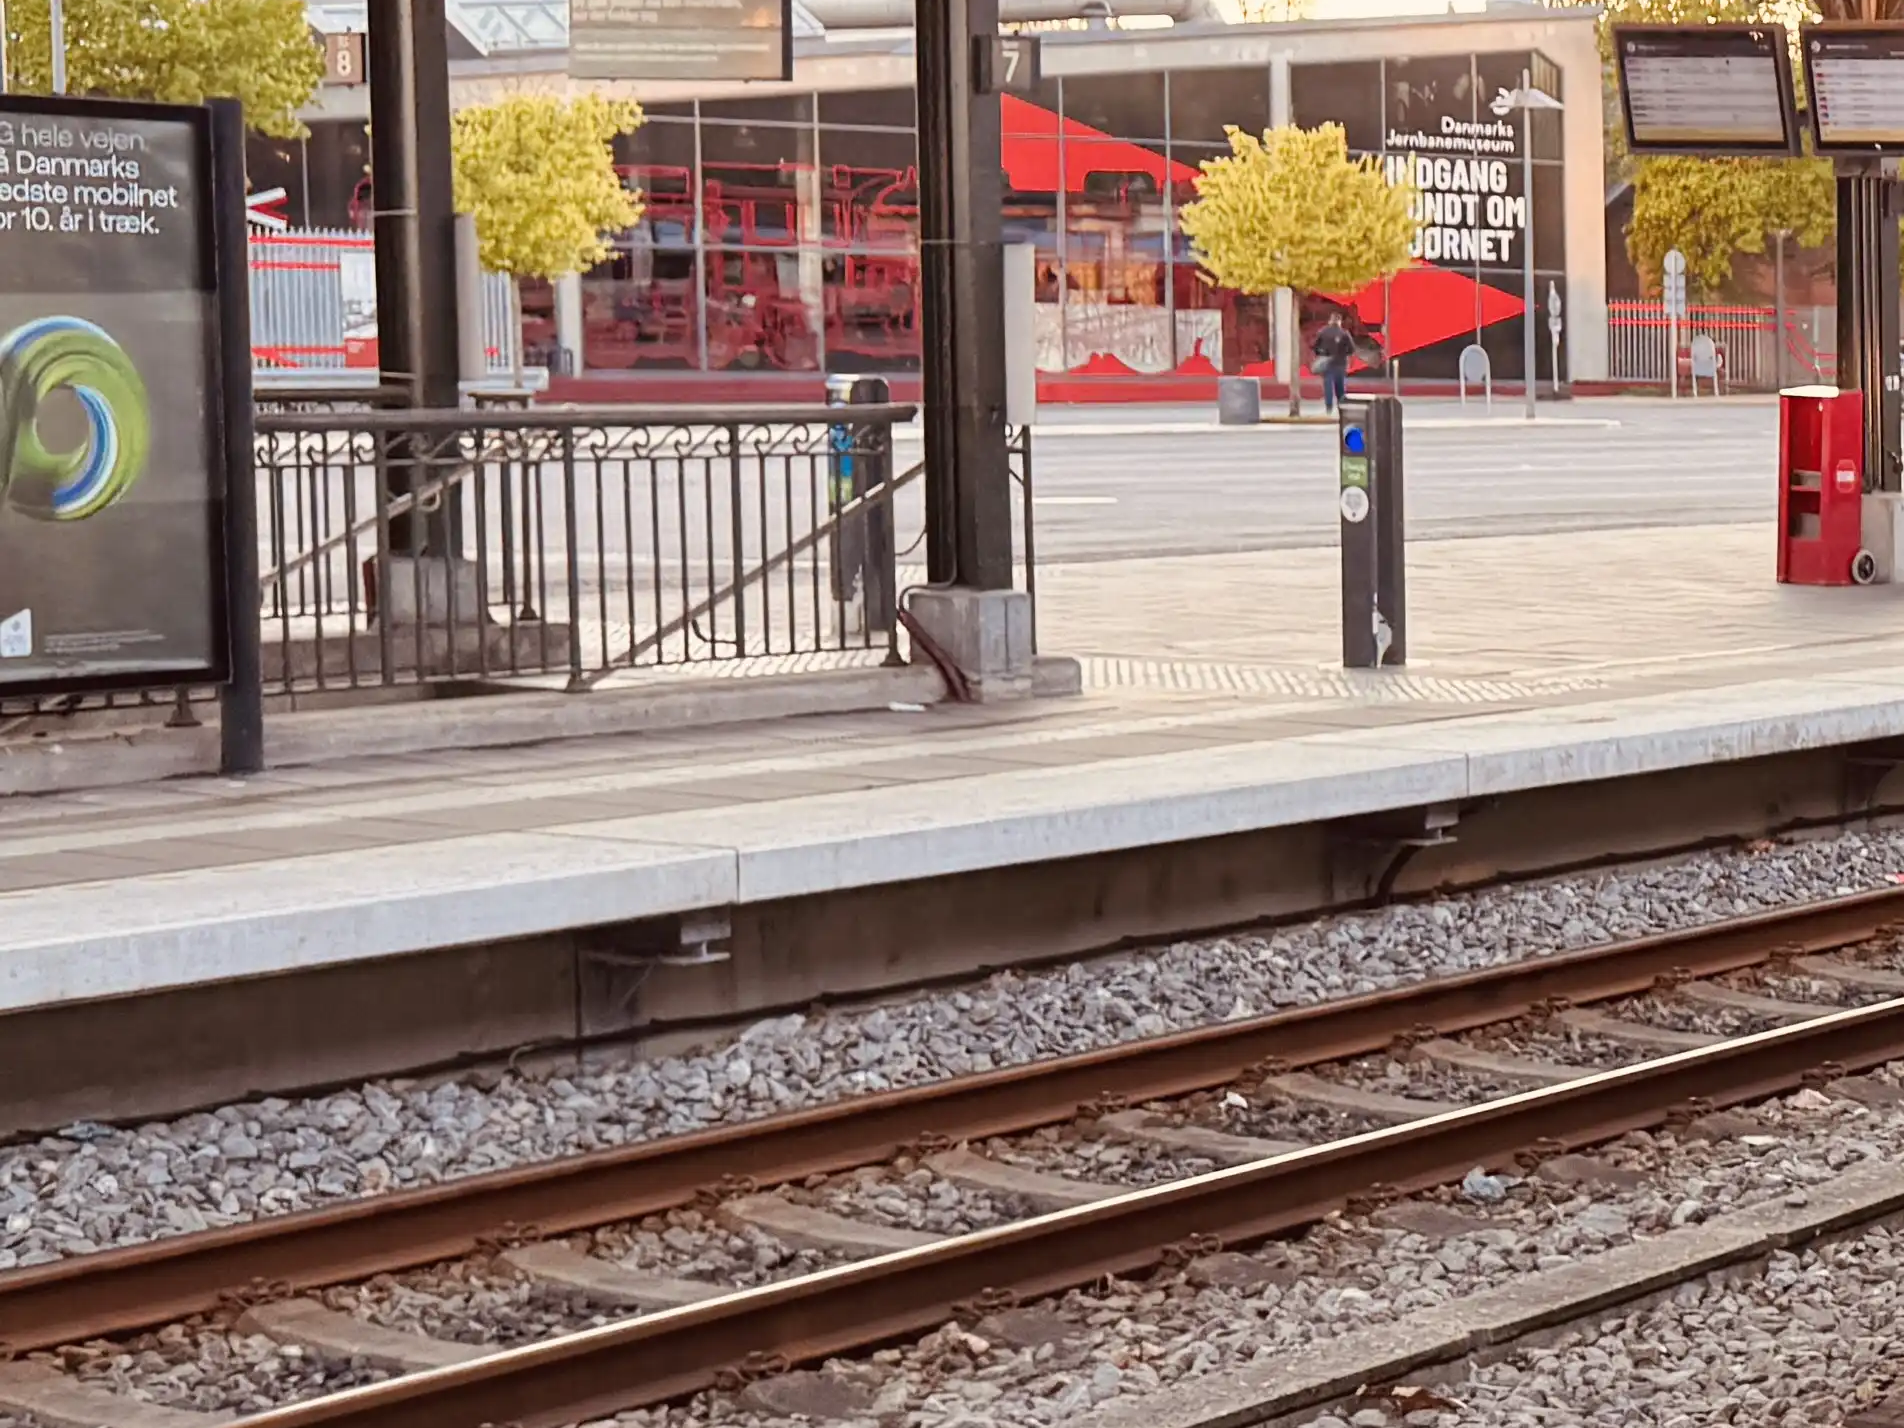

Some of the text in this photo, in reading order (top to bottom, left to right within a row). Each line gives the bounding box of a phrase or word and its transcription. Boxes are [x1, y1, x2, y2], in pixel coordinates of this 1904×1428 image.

[337, 50, 351, 76] 8
[1002, 51, 1019, 82] 7
[21, 123, 73, 148] hele
[1441, 115, 1514, 137] Danmarks
[16, 150, 140, 180] Danmarks
[1386, 155, 1508, 193] INDGANG
[0, 178, 178, 208] edste mobilnet
[21, 206, 54, 231] 10.
[60, 206, 84, 232] år
[88, 208, 94, 232] i
[99, 210, 160, 235] træk.
[1406, 192, 1526, 229] UNDT OM
[1407, 225, 1515, 262] JØRNET
